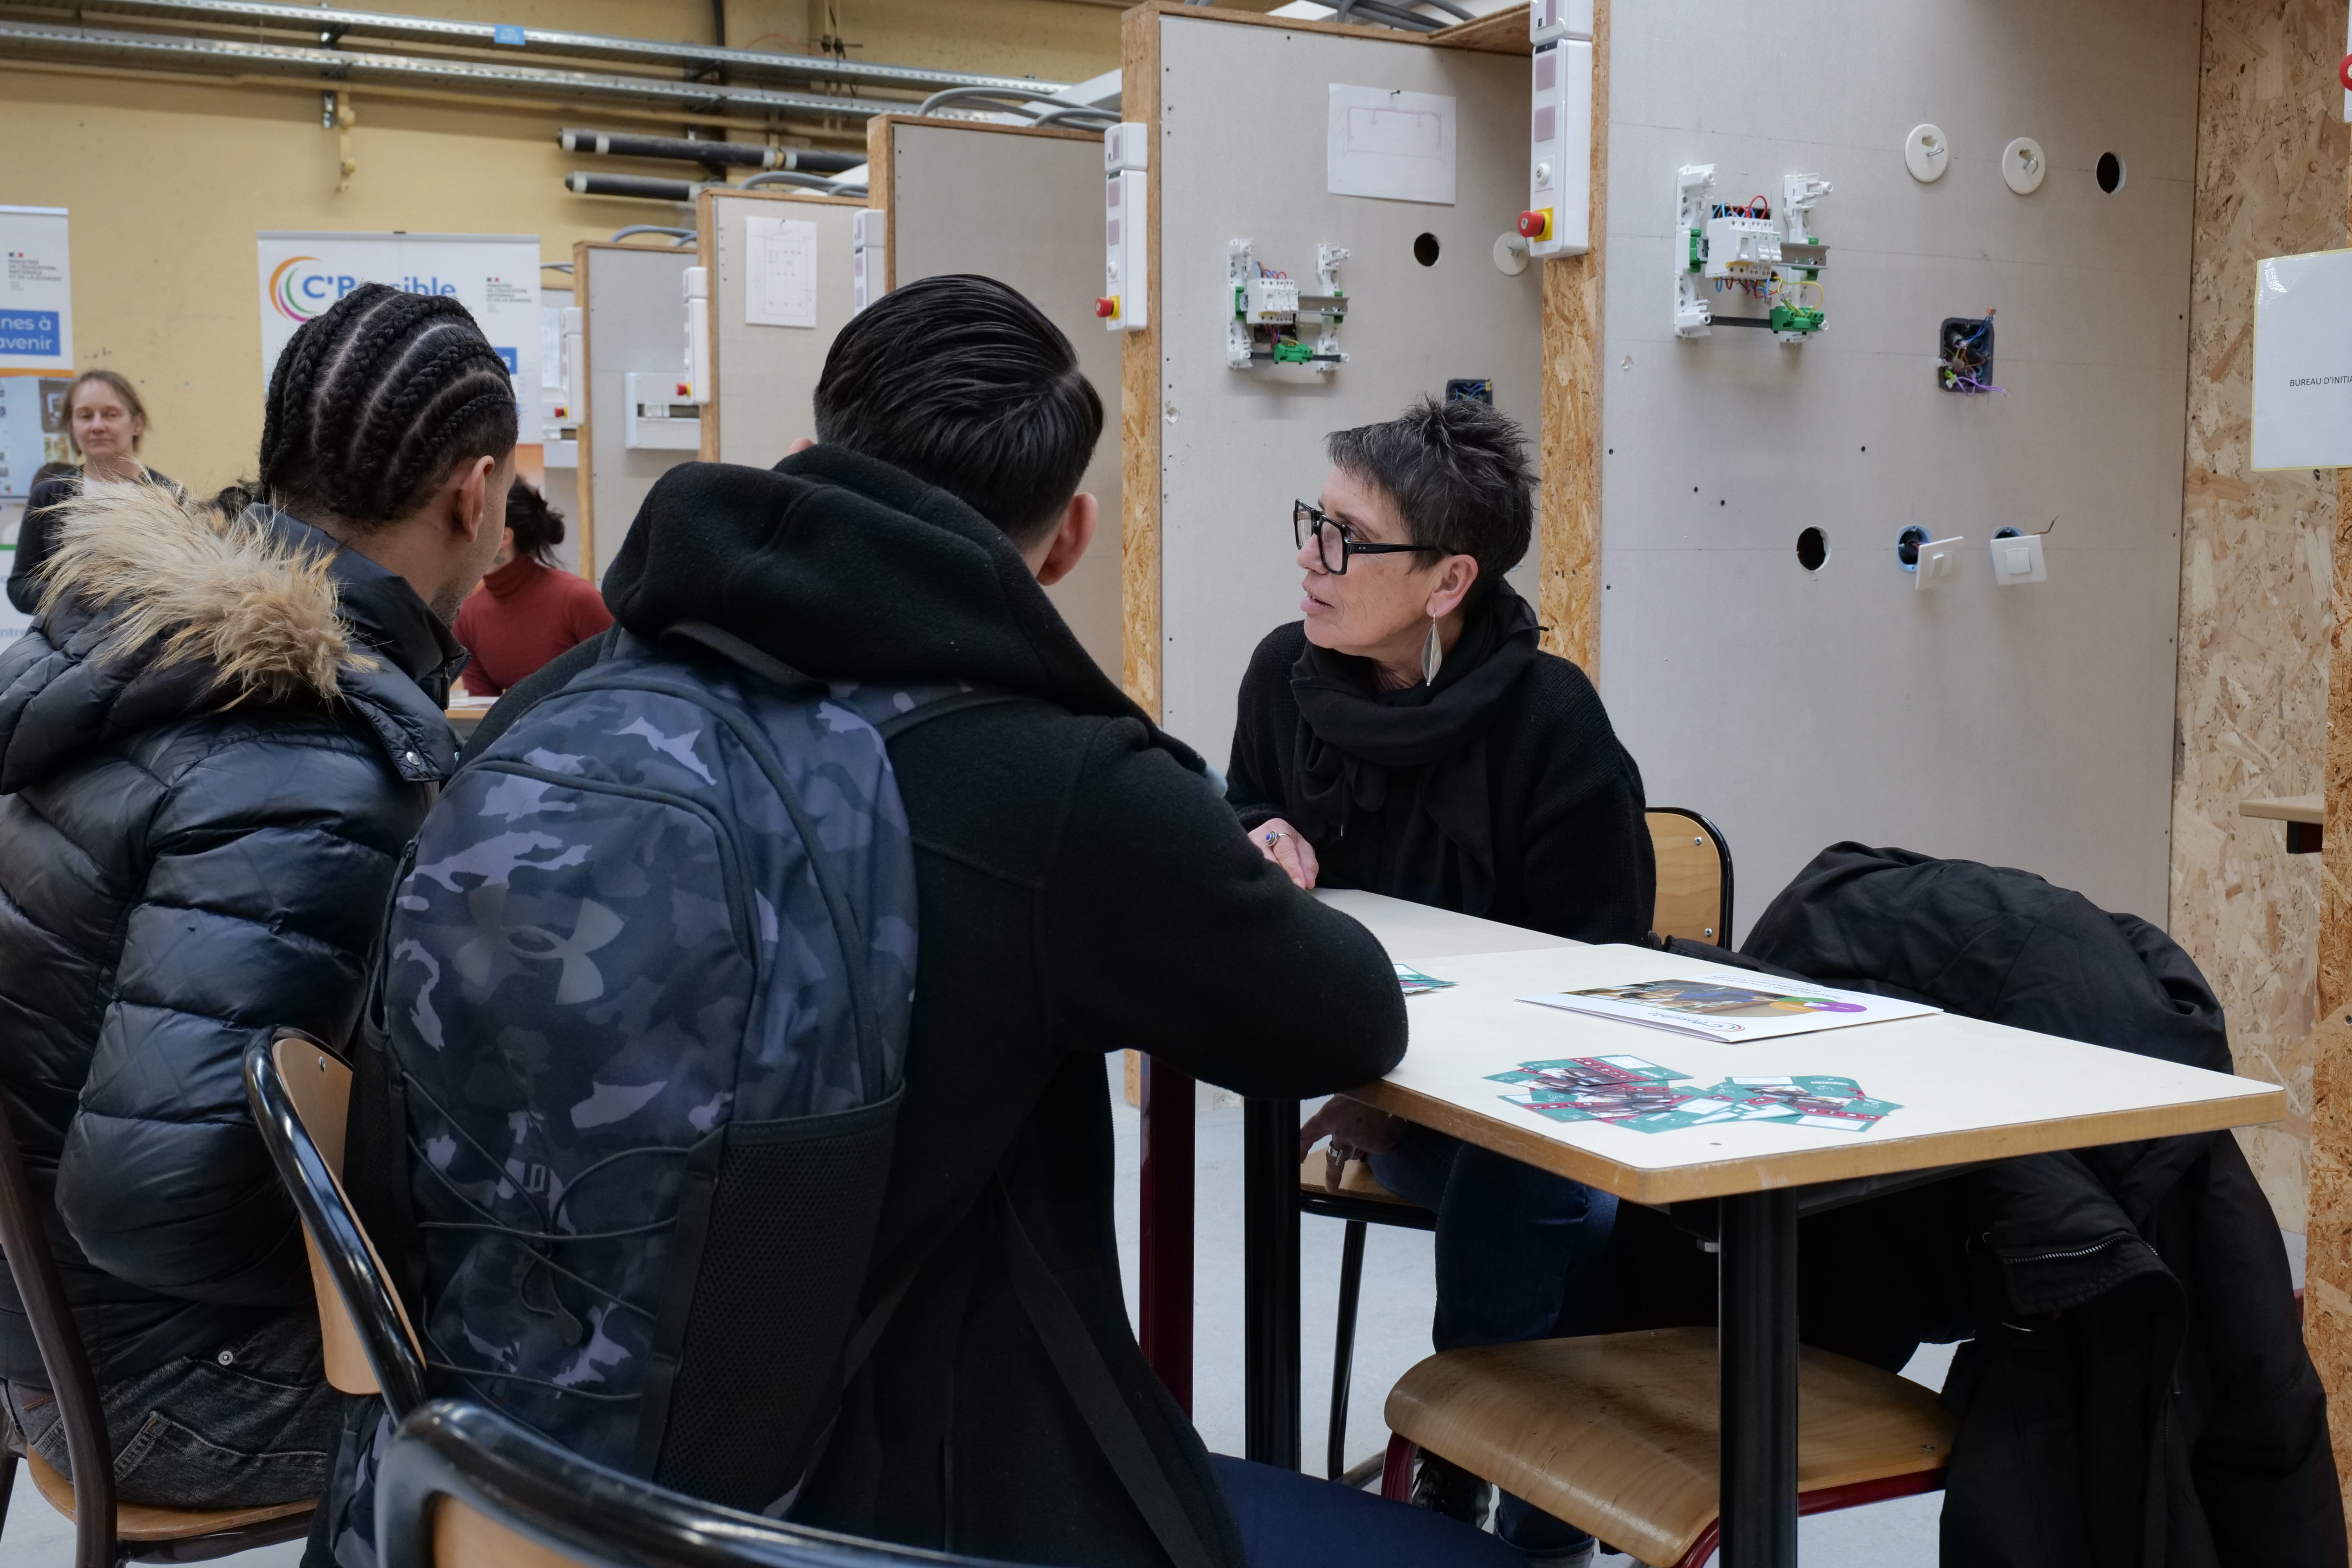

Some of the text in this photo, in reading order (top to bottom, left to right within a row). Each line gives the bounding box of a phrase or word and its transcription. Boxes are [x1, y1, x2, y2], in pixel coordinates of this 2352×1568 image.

[302, 275, 456, 299] C'Pible
[39, 315, 51, 331] à
[2290, 378, 2321, 387] BUREAU
